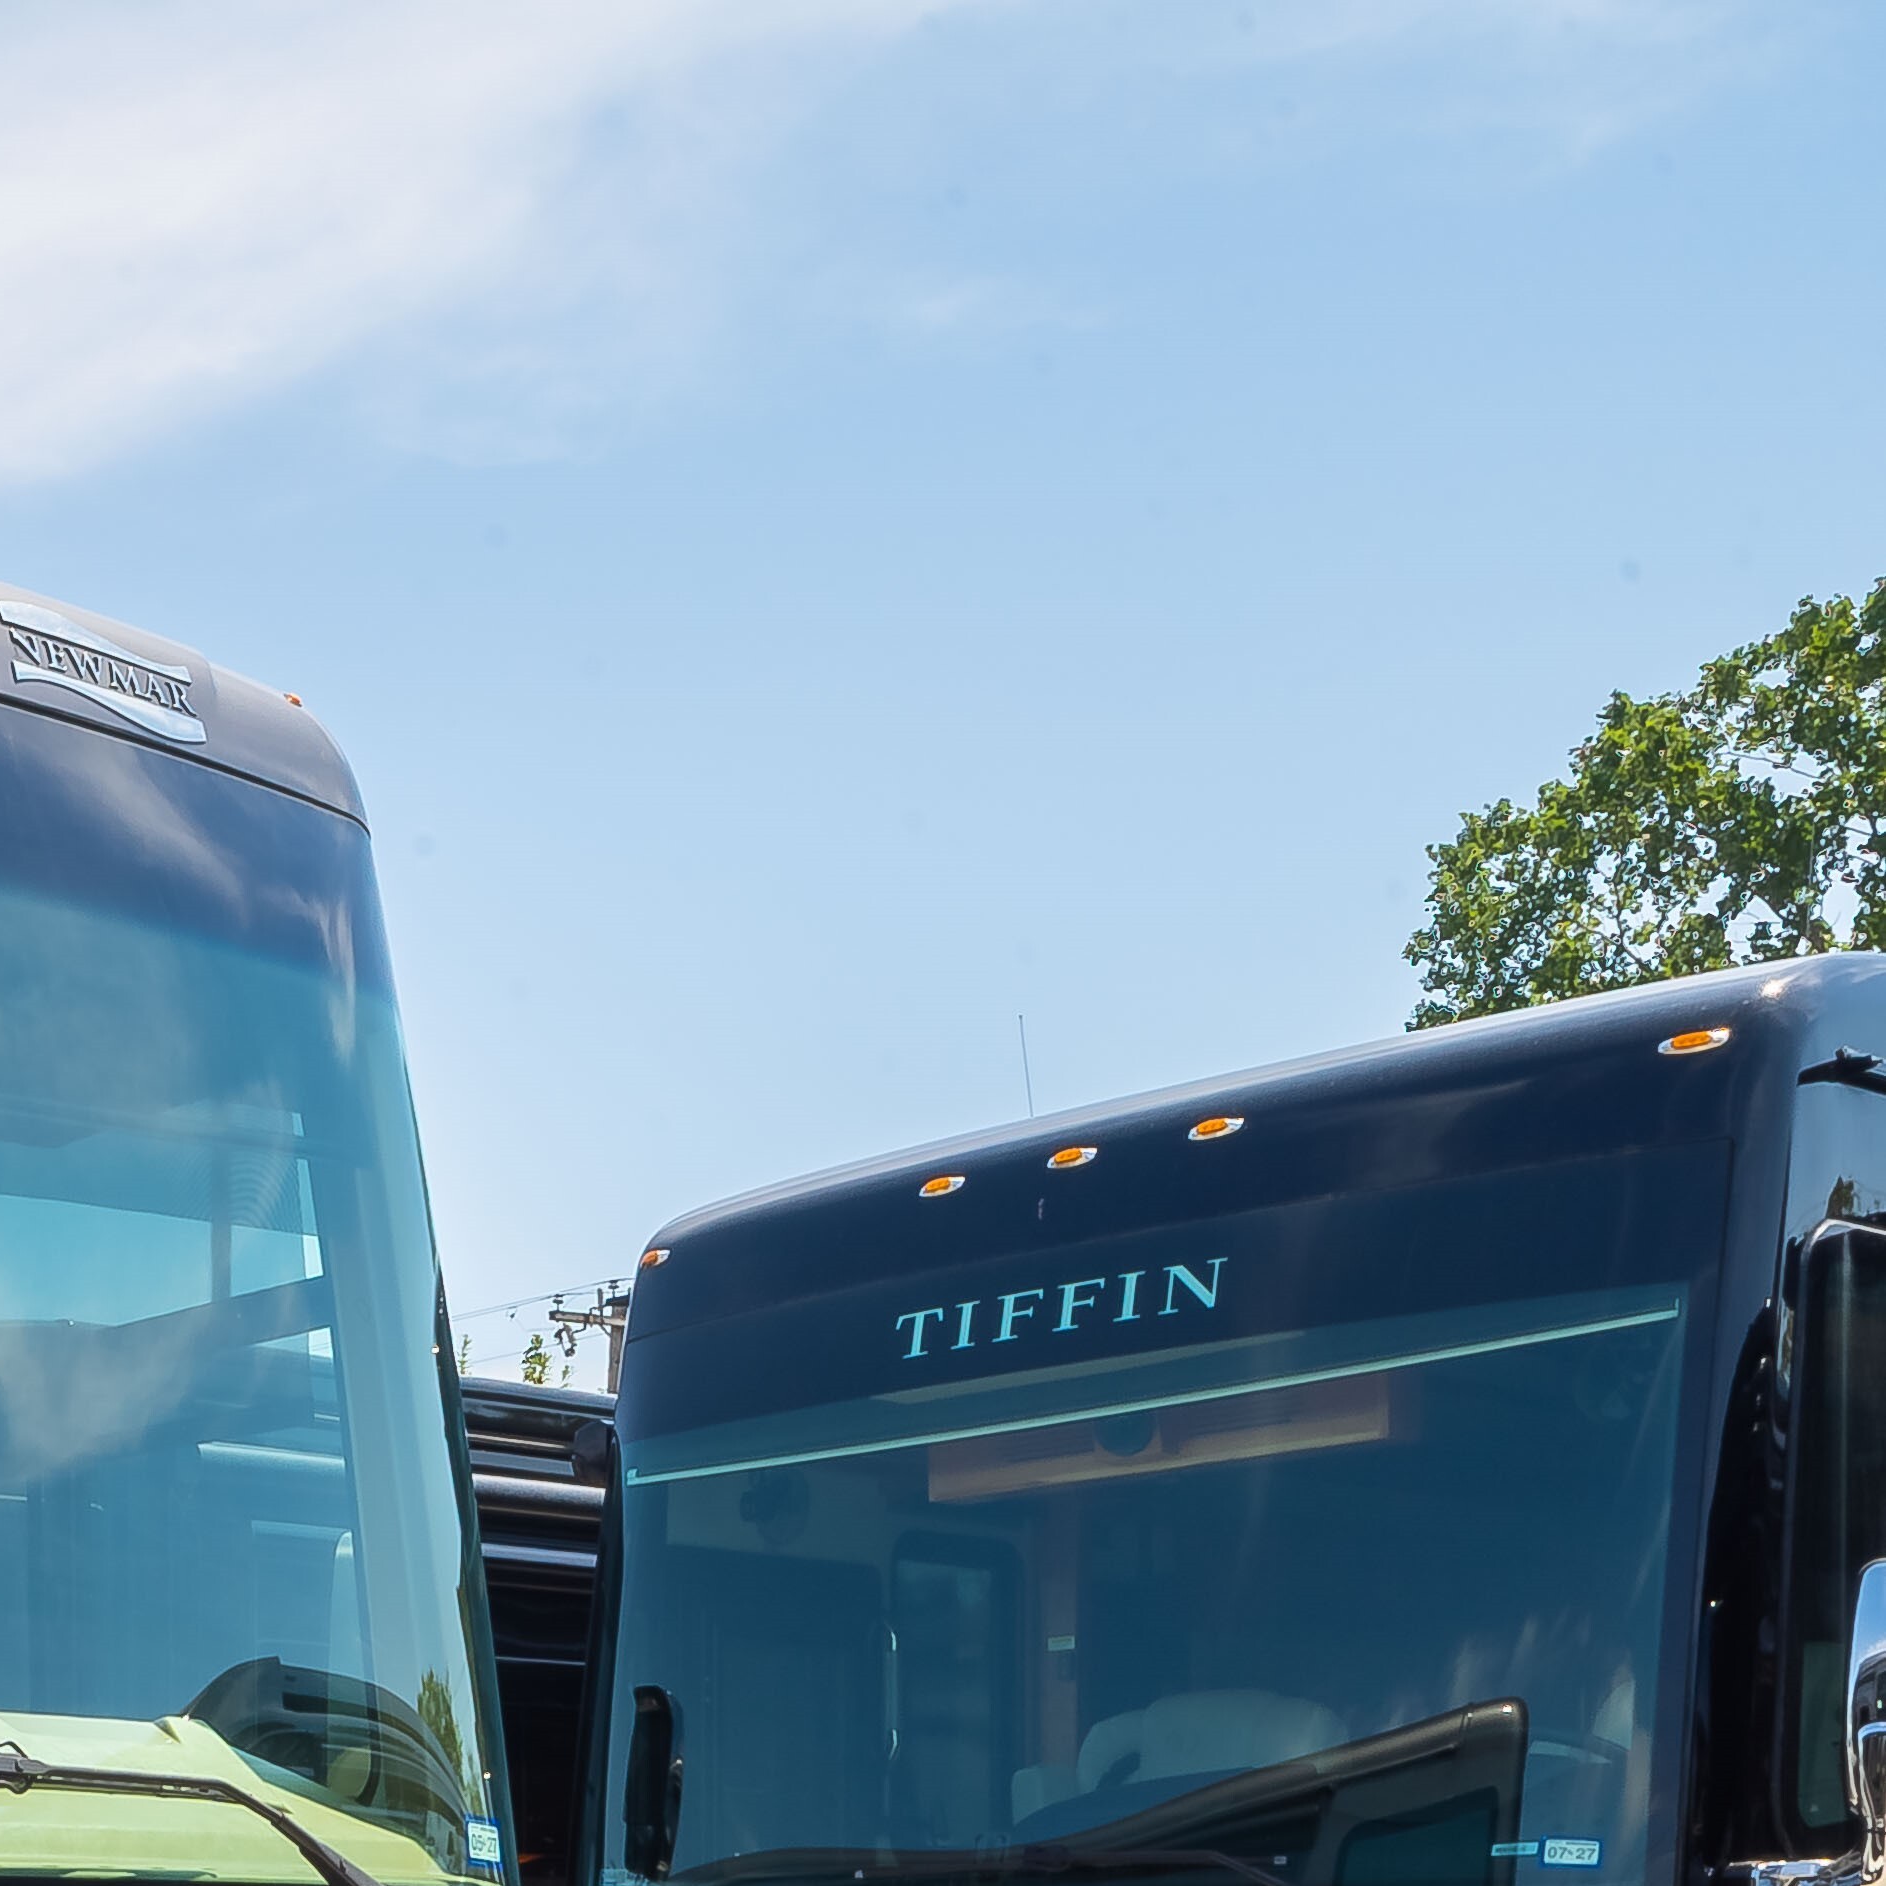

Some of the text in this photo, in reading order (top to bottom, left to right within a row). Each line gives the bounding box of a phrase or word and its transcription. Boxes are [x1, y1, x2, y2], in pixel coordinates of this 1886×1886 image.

[8, 626, 198, 717] NEWMAR
[895, 1257, 1229, 1360] TIFFIN
[1548, 1847, 1597, 1860] 07 27
